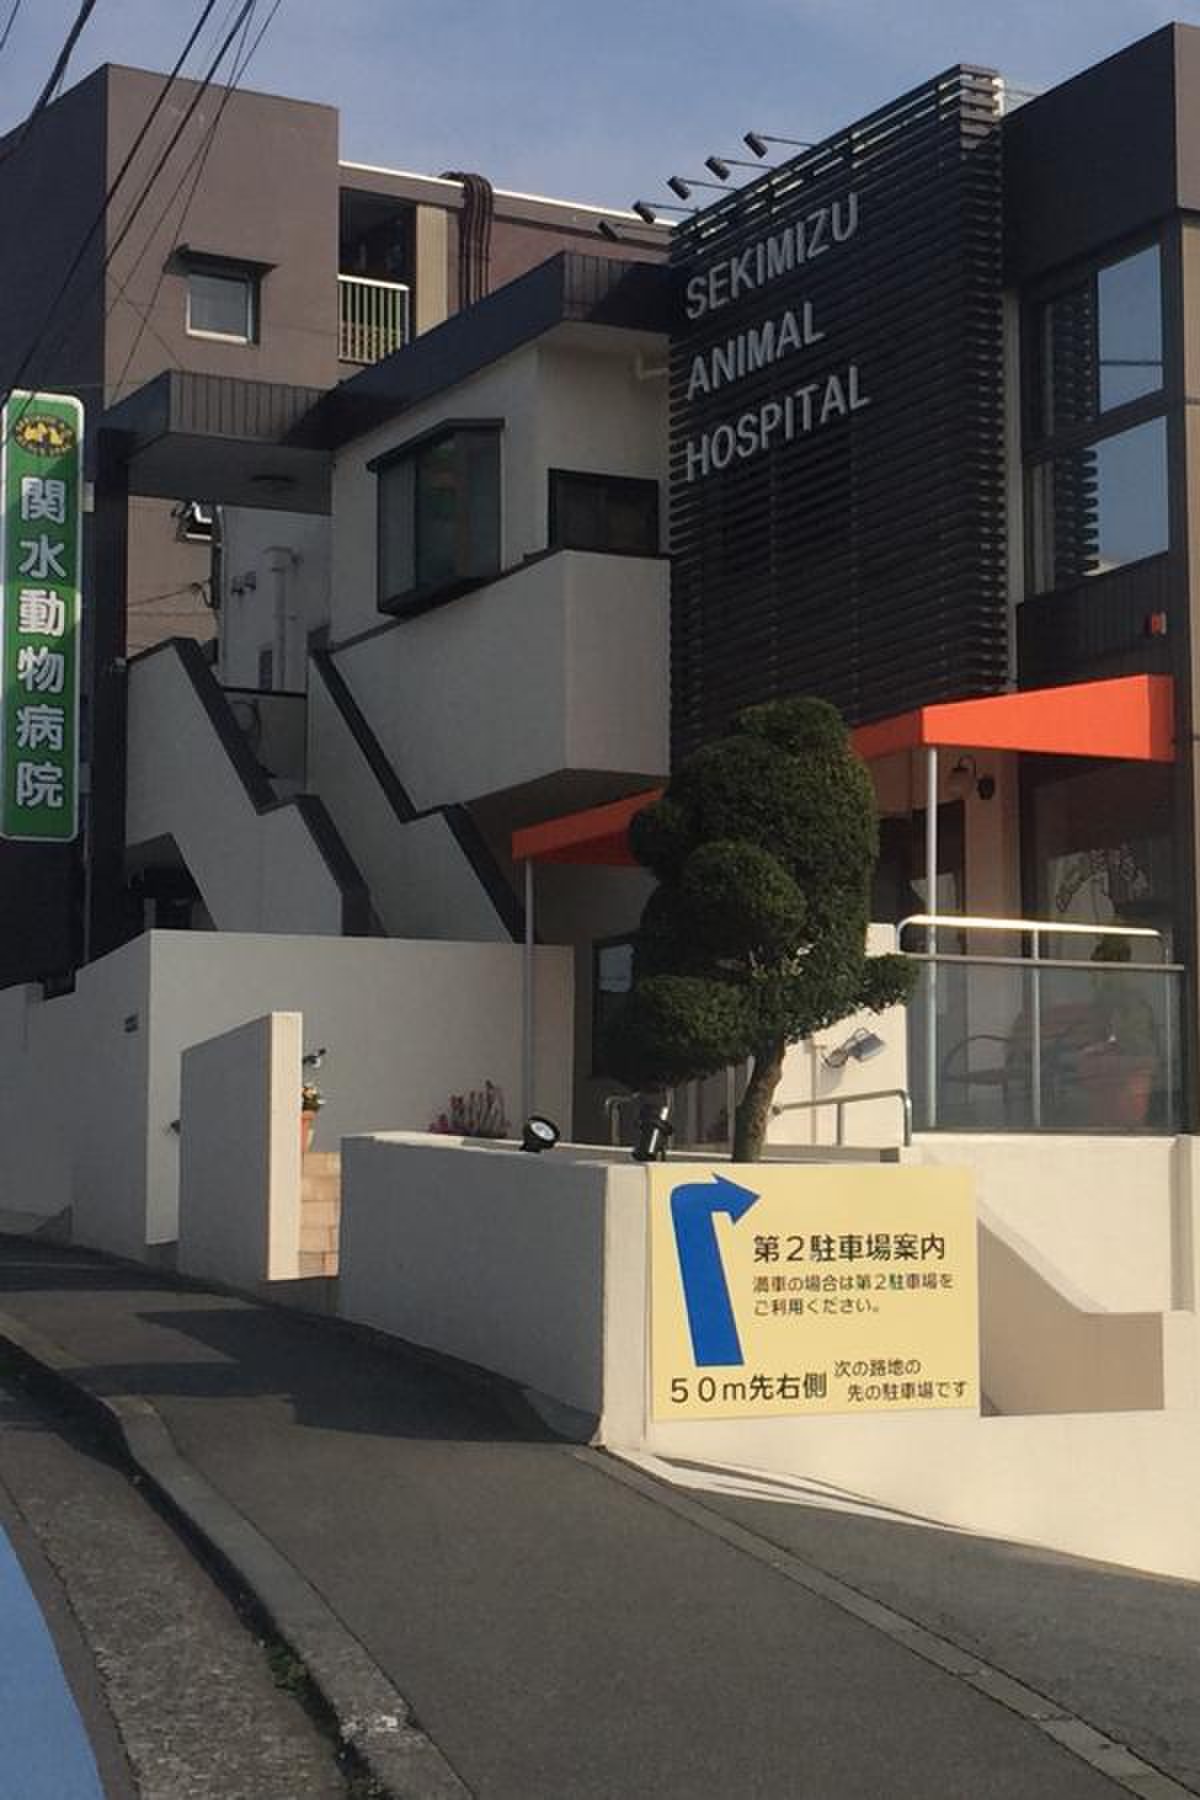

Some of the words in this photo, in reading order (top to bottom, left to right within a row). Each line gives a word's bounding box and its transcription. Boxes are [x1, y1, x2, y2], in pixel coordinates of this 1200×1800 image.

[686, 192, 859, 319] SEKIMIZU
[687, 301, 825, 400] ANIMAL
[687, 365, 870, 481] HOSPITAL
[15, 476, 67, 808] 関水動物病院
[753, 1233, 945, 1263] 第2駐車場案内
[671, 1372, 828, 1403] 50m先右側
[834, 1359, 921, 1377] 次の路地の
[847, 1380, 968, 1402] 先の駐車場です
